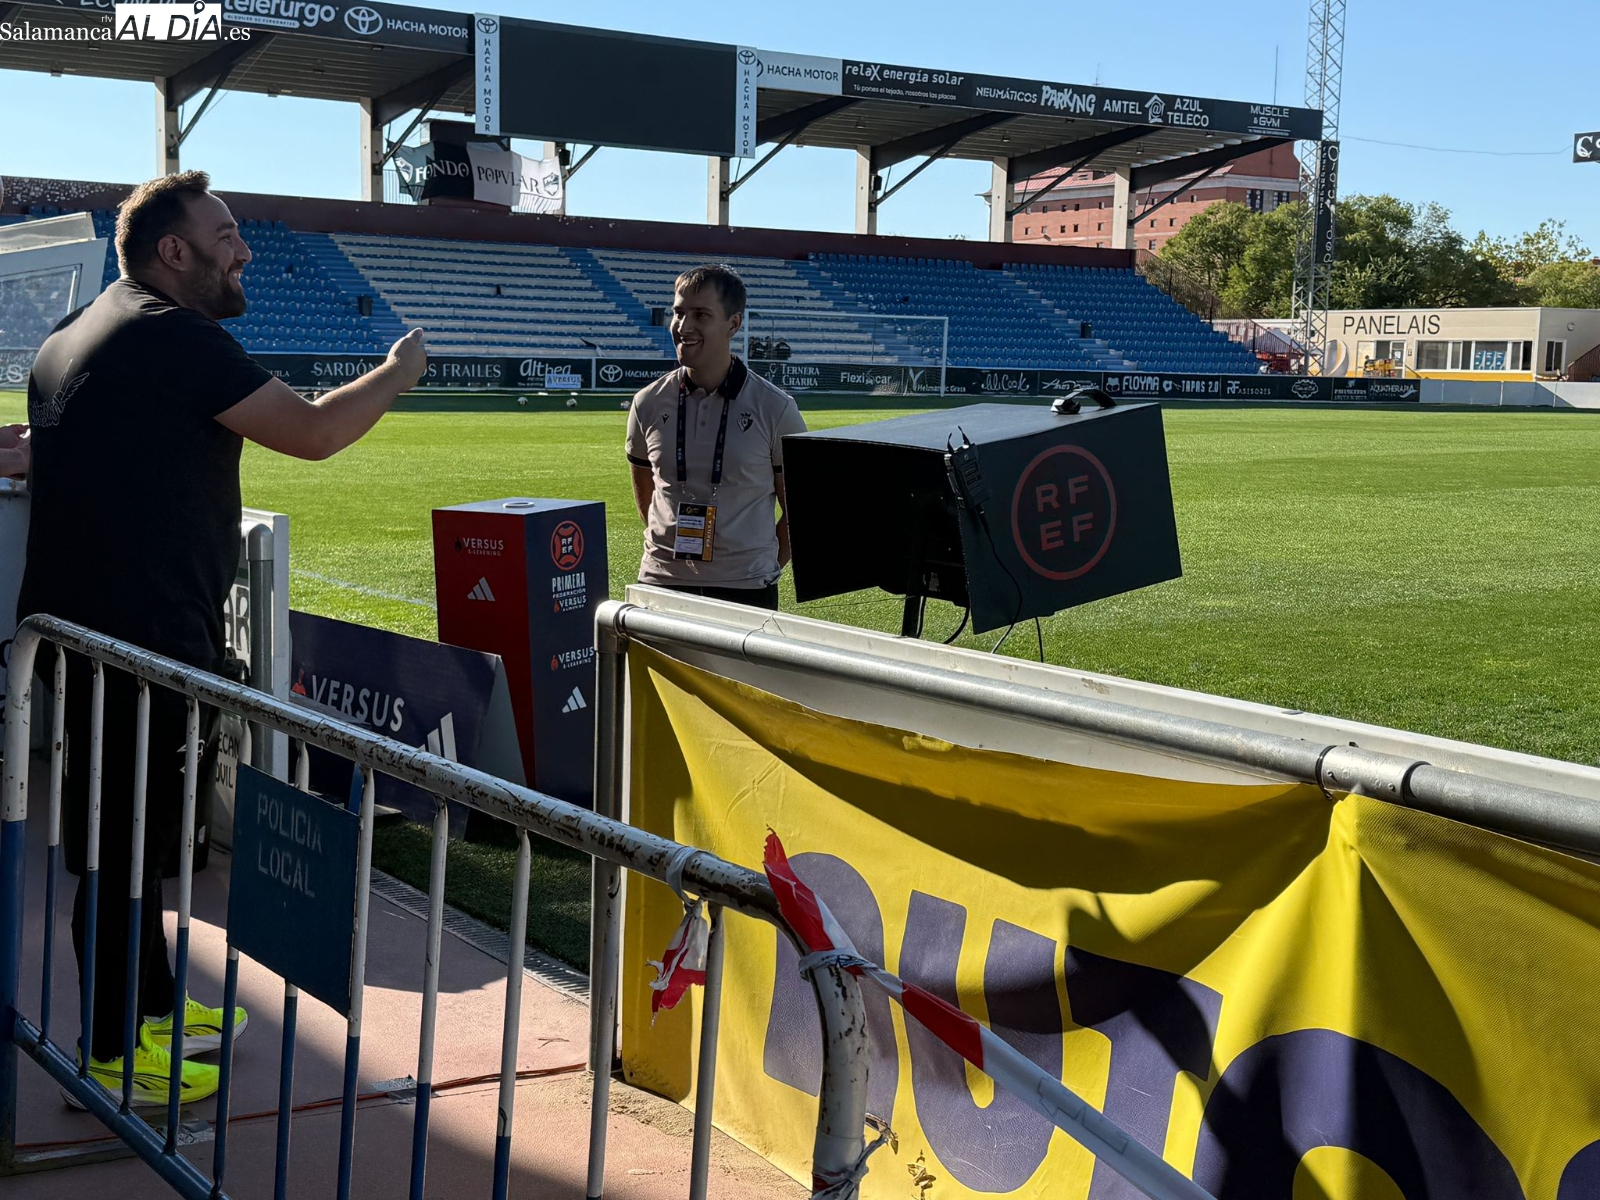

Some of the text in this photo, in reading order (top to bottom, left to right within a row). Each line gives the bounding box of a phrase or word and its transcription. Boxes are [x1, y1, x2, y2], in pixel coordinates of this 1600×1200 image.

[386, 19, 469, 39] HACHA MOTOR
[767, 64, 838, 82] HACHA MOTOR
[845, 64, 964, 86] relaX energía solar
[483, 38, 491, 133] HACHA MOTOR
[861, 85, 879, 93] pones
[905, 90, 928, 98] nosotros
[938, 92, 957, 101] placas
[976, 84, 1097, 116] NEUMÁTICOS PARKING
[1103, 99, 1142, 115] AMTEL
[1174, 98, 1203, 113] AZUL
[1167, 111, 1209, 127] TELECO
[1250, 105, 1289, 118] MUSCLE
[1259, 116, 1280, 128] GYM
[742, 115, 750, 156] MOTOR
[415, 160, 469, 184] FONDO
[1343, 314, 1441, 335] PANELAIS
[442, 363, 501, 378] FRAILES
[625, 370, 649, 378] HACHA
[780, 363, 820, 376] TERNERA
[782, 374, 818, 386] CHARRA
[1122, 375, 1160, 391] FLOYMA
[1181, 380, 1219, 393] TAPAS 2.0
[462, 537, 504, 550] VERSUS
[552, 572, 586, 593] PRIMERA
[559, 595, 587, 608] VERSUS
[558, 646, 595, 664] VERSUS
[311, 674, 406, 732] VERSUS
[257, 792, 322, 854] POLICIA
[258, 841, 315, 898] LOCAL
